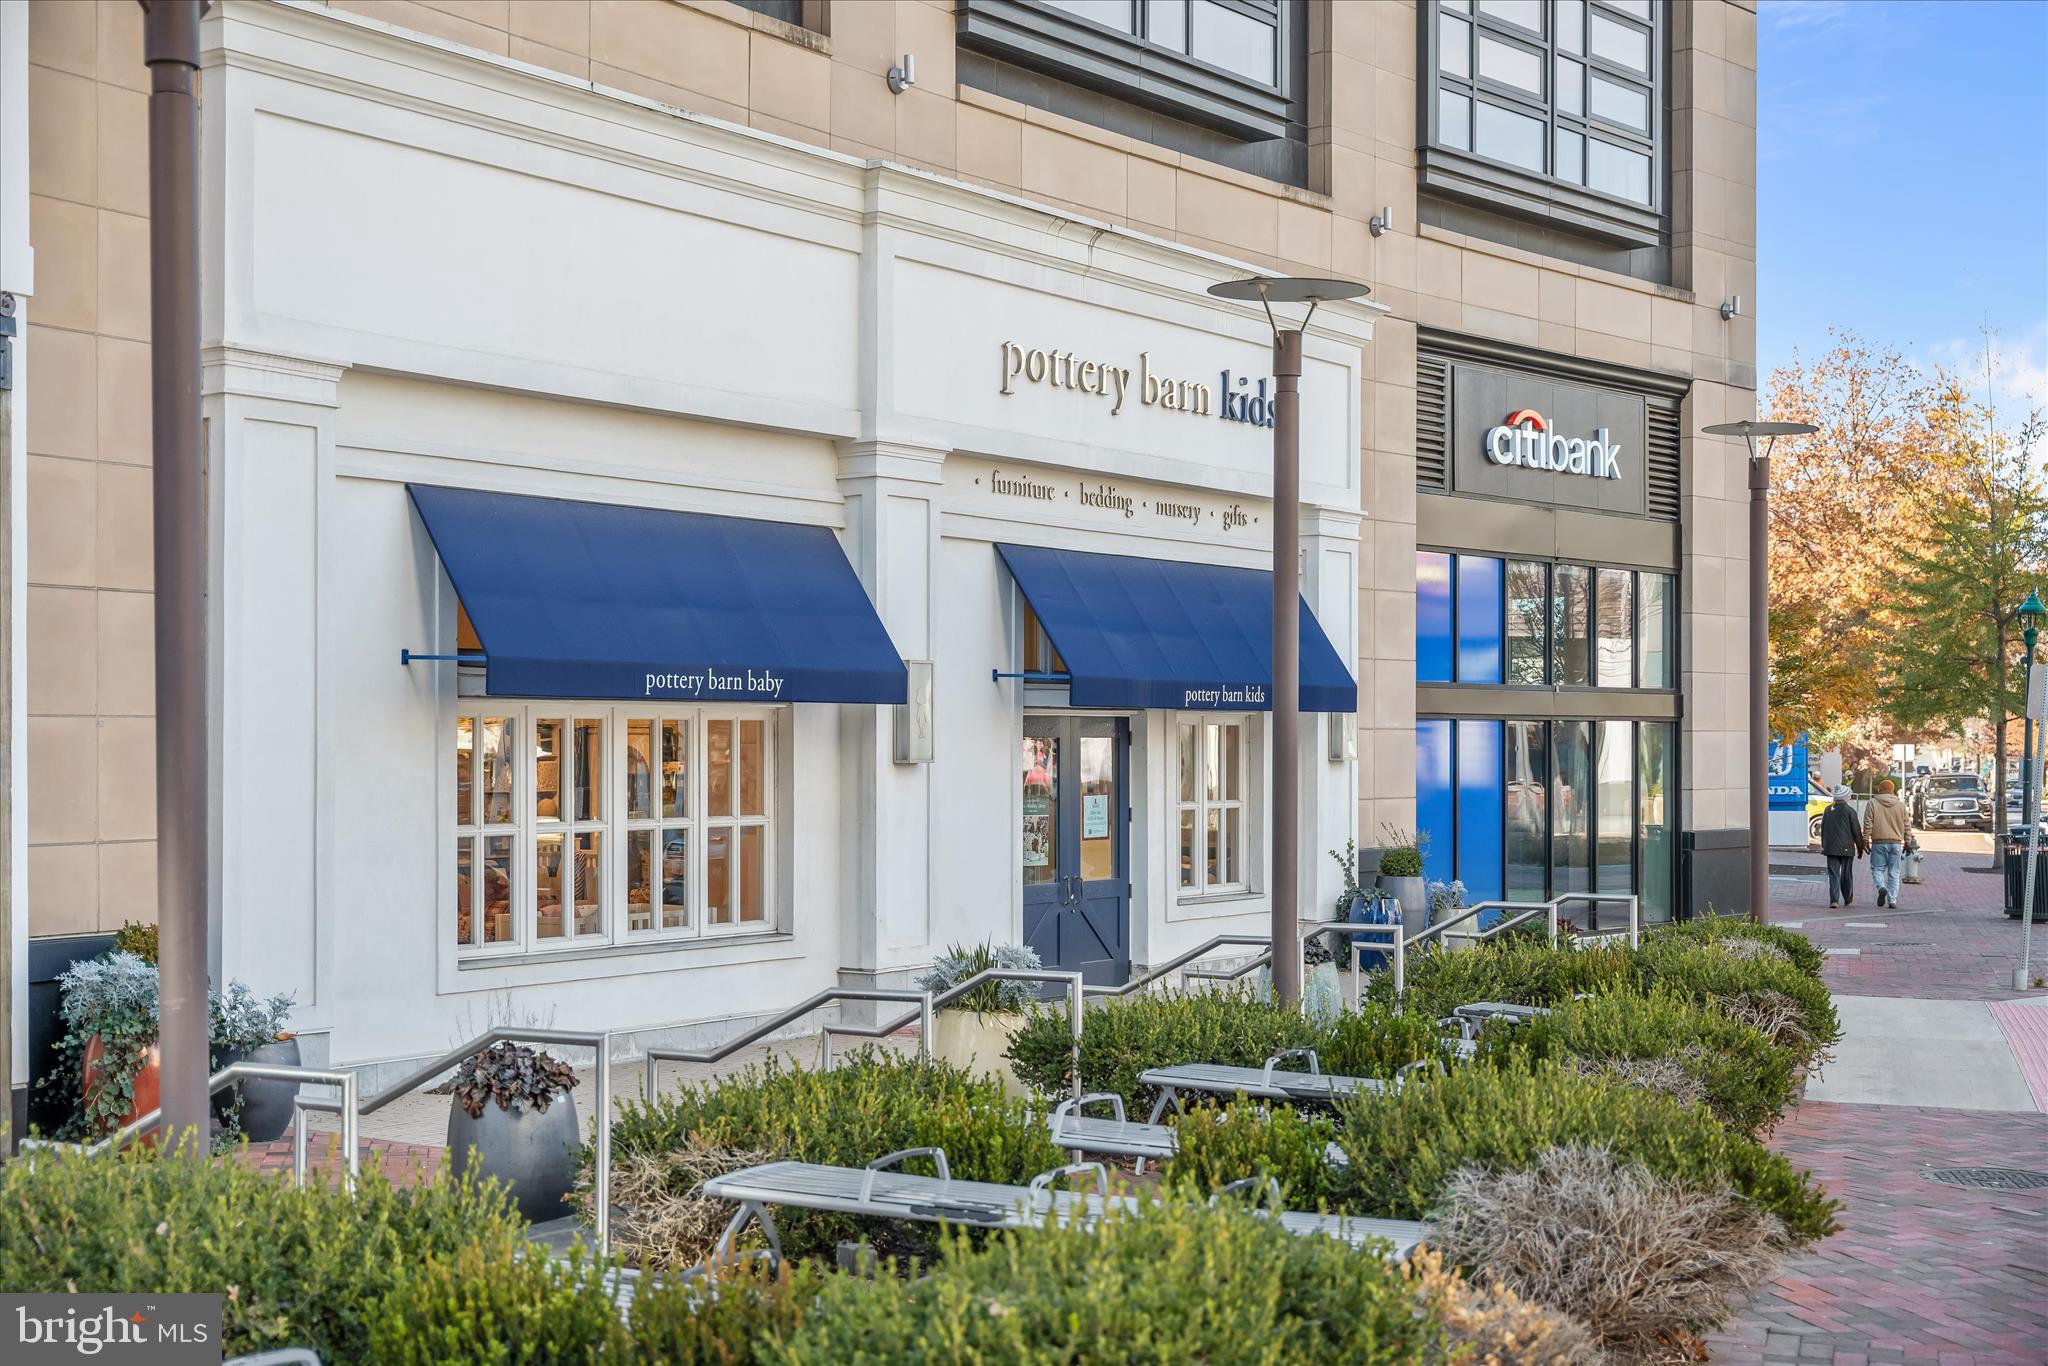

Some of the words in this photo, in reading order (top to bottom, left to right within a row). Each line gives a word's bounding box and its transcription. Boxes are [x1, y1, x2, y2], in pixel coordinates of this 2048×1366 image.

[1000, 340, 1131, 415] pottery
[1140, 351, 1212, 415] barn
[1219, 369, 1274, 428] kids
[1486, 419, 1622, 480] citibank
[991, 469, 1056, 502] furniture
[1079, 482, 1133, 518] bedding
[1155, 500, 1201, 526] nursery
[1222, 505, 1248, 531] gifts
[645, 673, 704, 696] pottery
[708, 668, 743, 690] barn
[748, 669, 784, 698] baby
[1185, 690, 1220, 706] pottery
[1222, 684, 1243, 702] barn
[1245, 685, 1265, 702] kids
[1768, 786, 1804, 795] NDA
